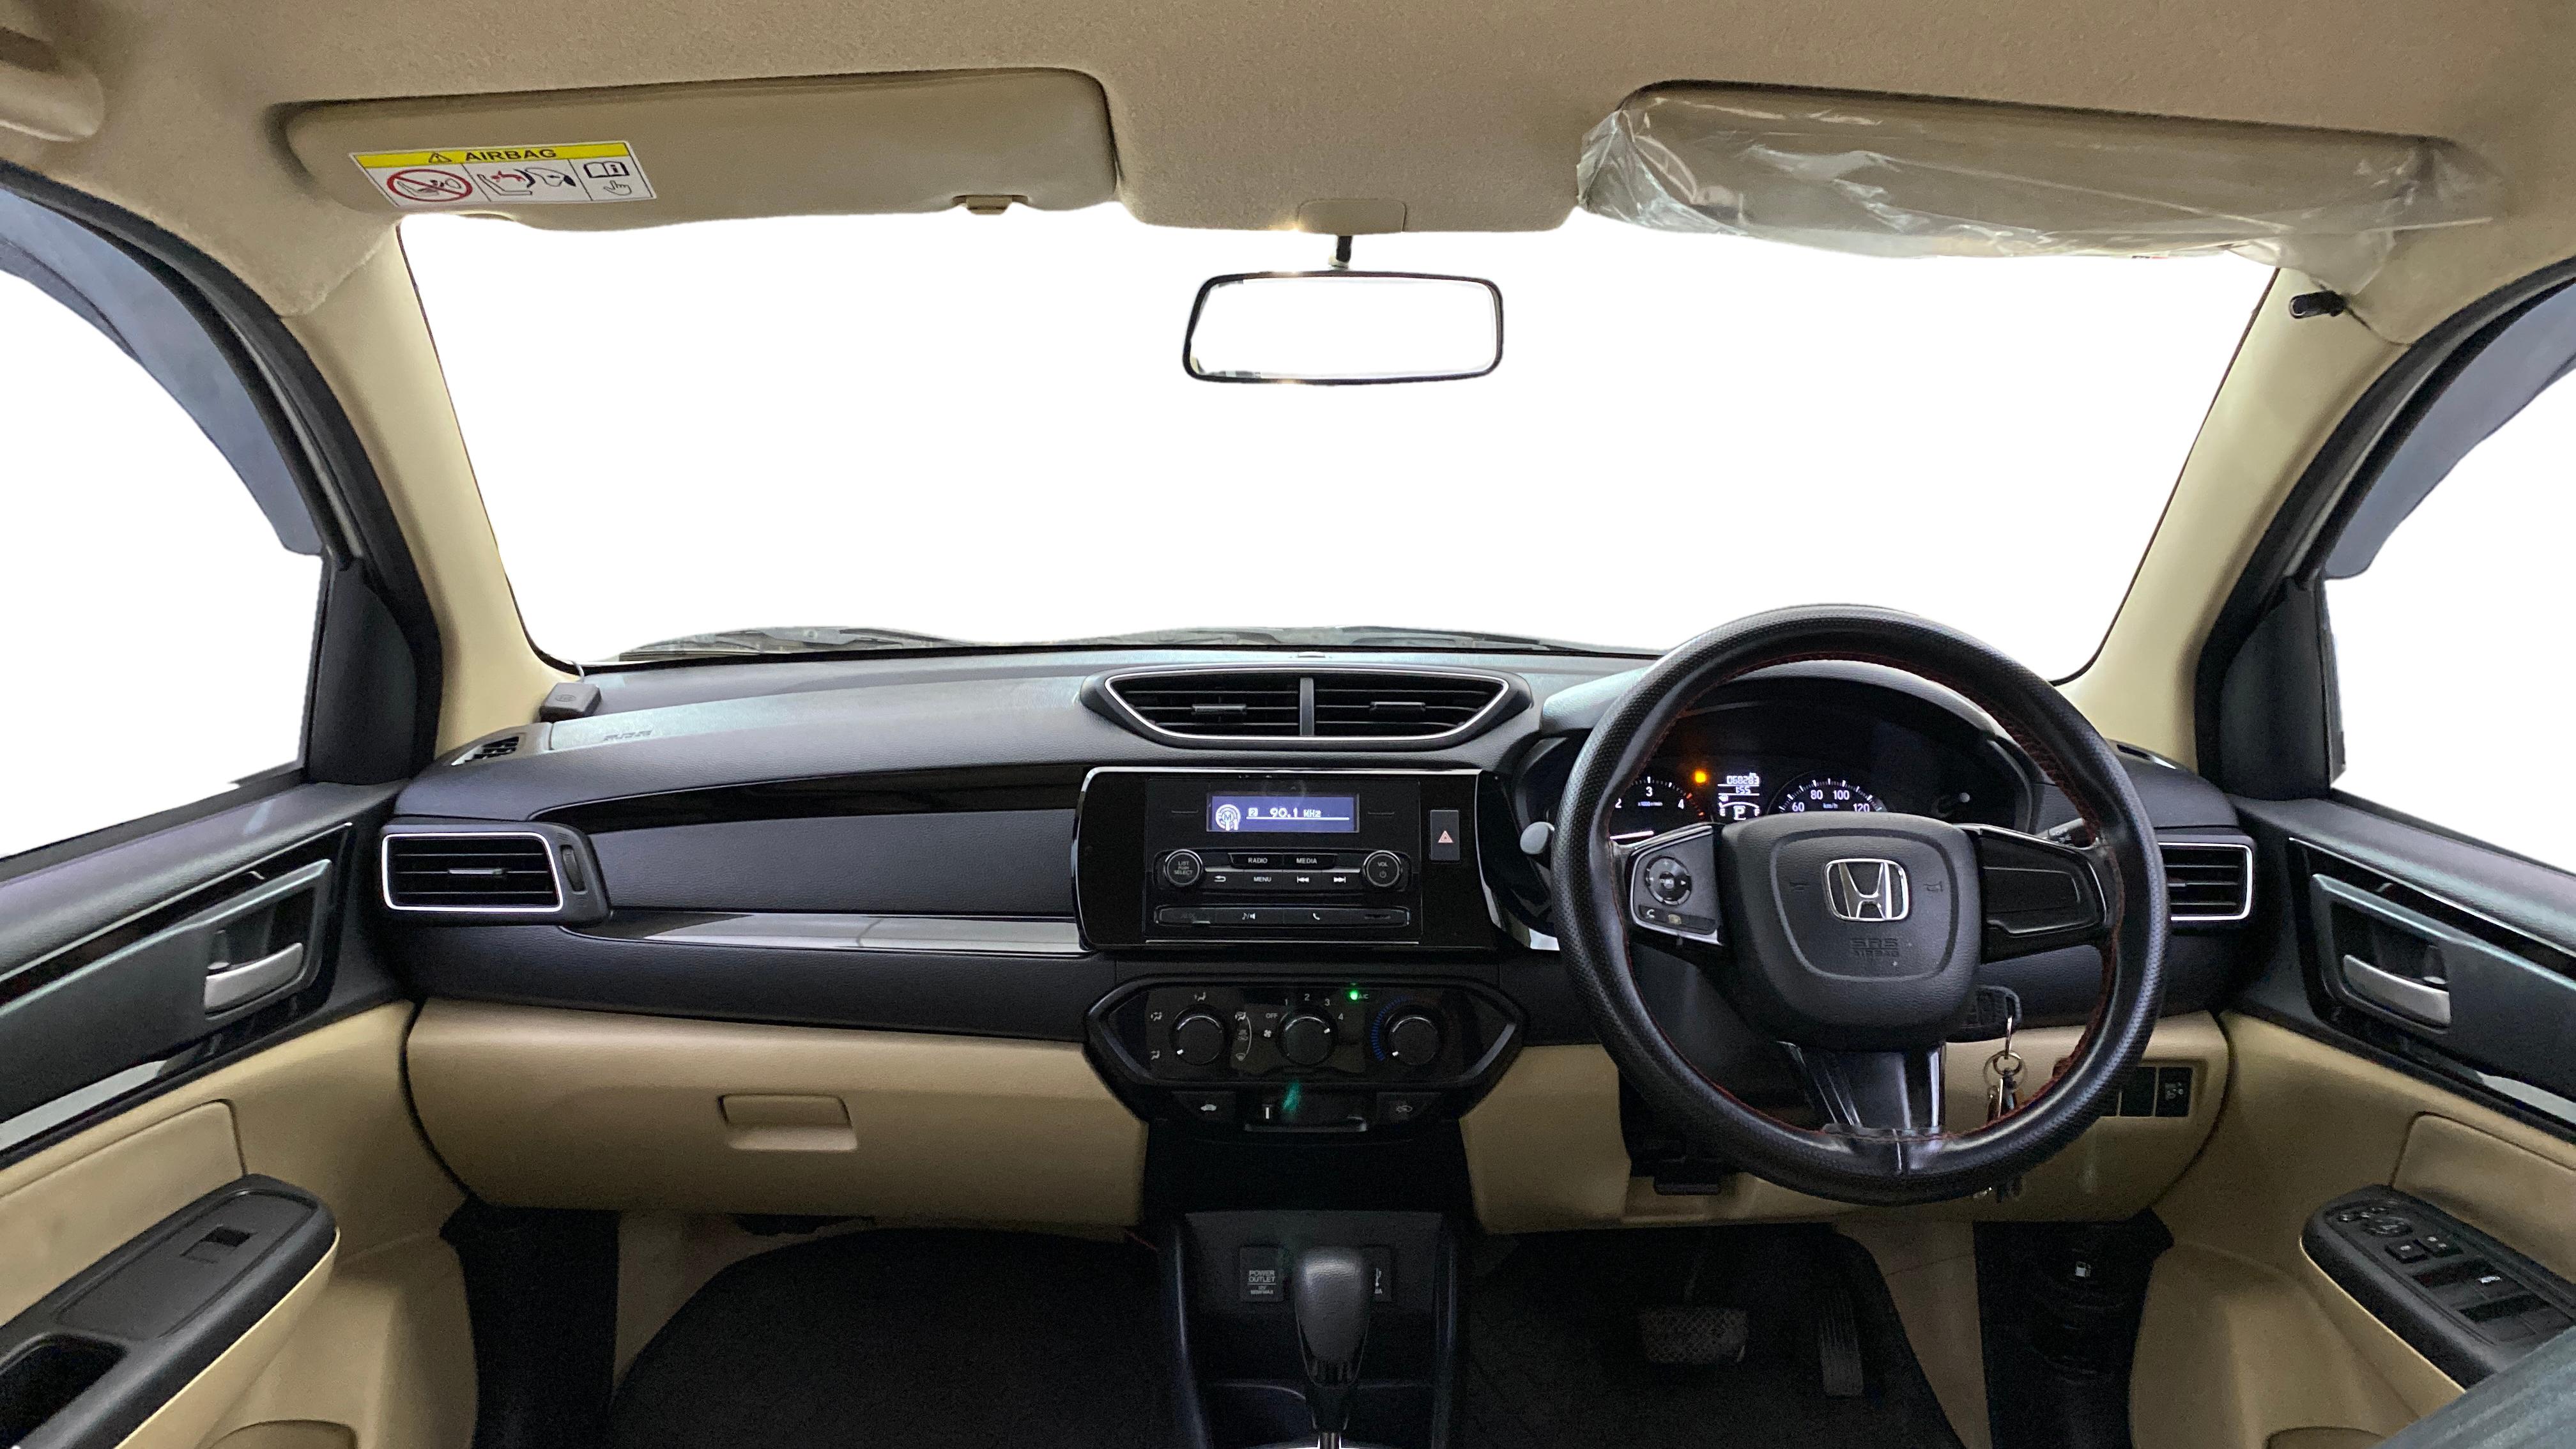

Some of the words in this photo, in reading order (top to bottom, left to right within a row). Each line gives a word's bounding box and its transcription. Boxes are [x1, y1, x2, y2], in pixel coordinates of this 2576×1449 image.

[466, 149, 556, 161] AIRBAG
[1646, 786, 1653, 797] 3
[1810, 790, 1823, 800] 80
[1834, 790, 1850, 800] 100
[1614, 798, 1622, 808] 2
[1678, 799, 1684, 809] 4
[1792, 802, 1805, 812] 60
[1853, 803, 1870, 813] 120
[1269, 808, 1298, 818] 90.1
[1303, 809, 1321, 818] MHz
[1324, 999, 1331, 1007] 3
[1338, 1013, 1344, 1021] 4
